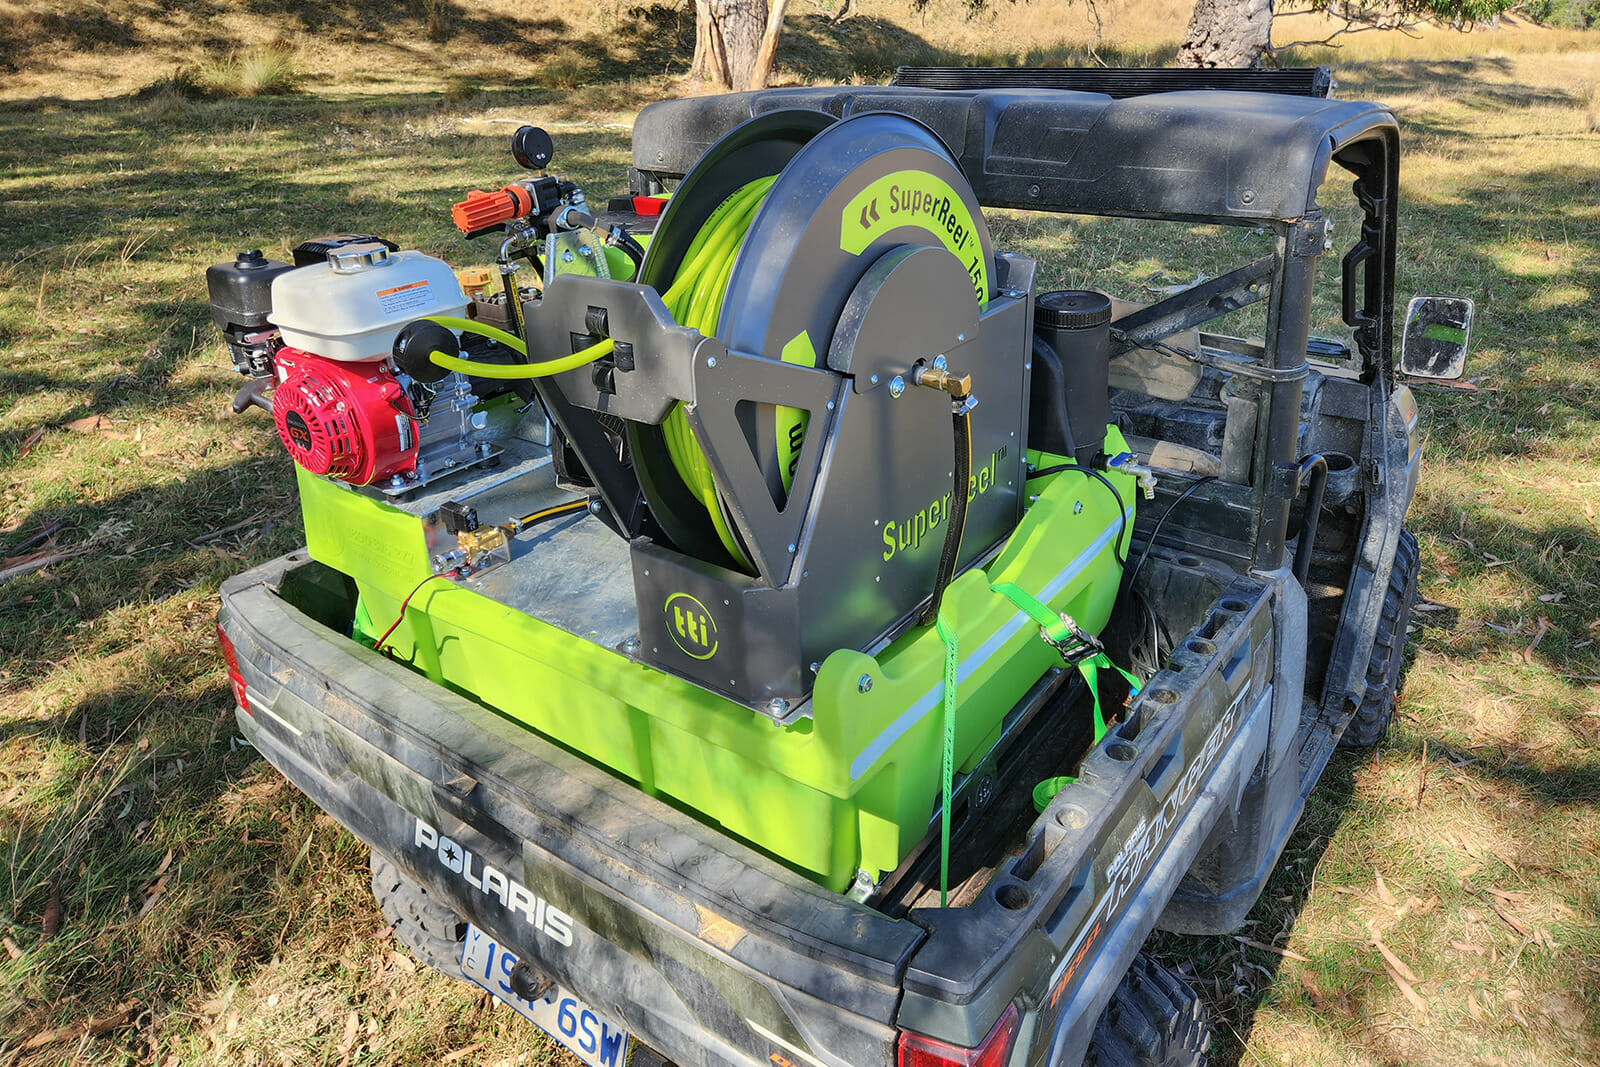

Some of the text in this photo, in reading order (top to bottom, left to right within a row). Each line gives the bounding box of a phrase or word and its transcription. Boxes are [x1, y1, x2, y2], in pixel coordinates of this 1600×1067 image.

[883, 446, 1007, 562] Supereel™
[673, 606, 708, 647] tti
[415, 817, 573, 948] POLARIS
[1106, 817, 1147, 883] POLARIS
[1050, 921, 1102, 1009] DIESEL
